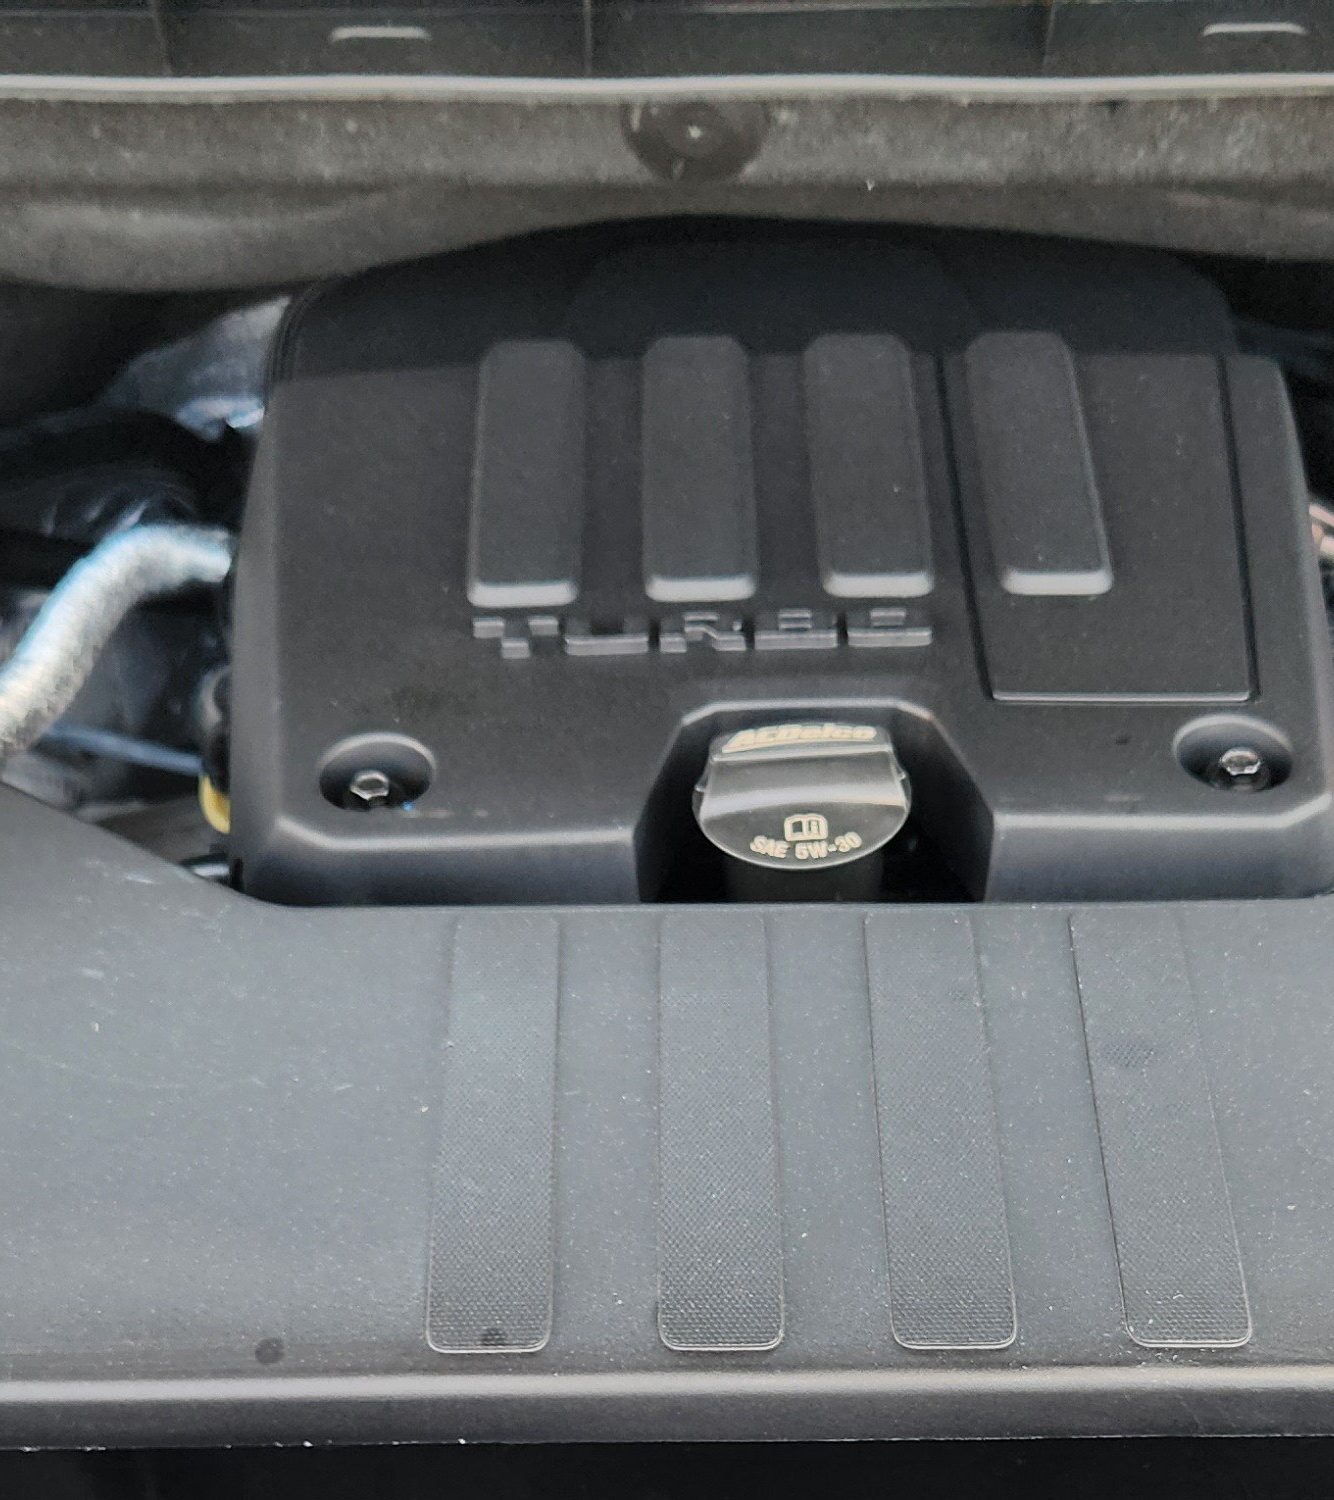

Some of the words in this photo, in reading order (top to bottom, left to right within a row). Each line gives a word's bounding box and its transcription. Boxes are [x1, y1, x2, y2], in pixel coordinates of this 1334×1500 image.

[722, 723, 877, 752] ACDelco
[750, 835, 791, 859] SAE
[795, 831, 862, 860] 5W-30
